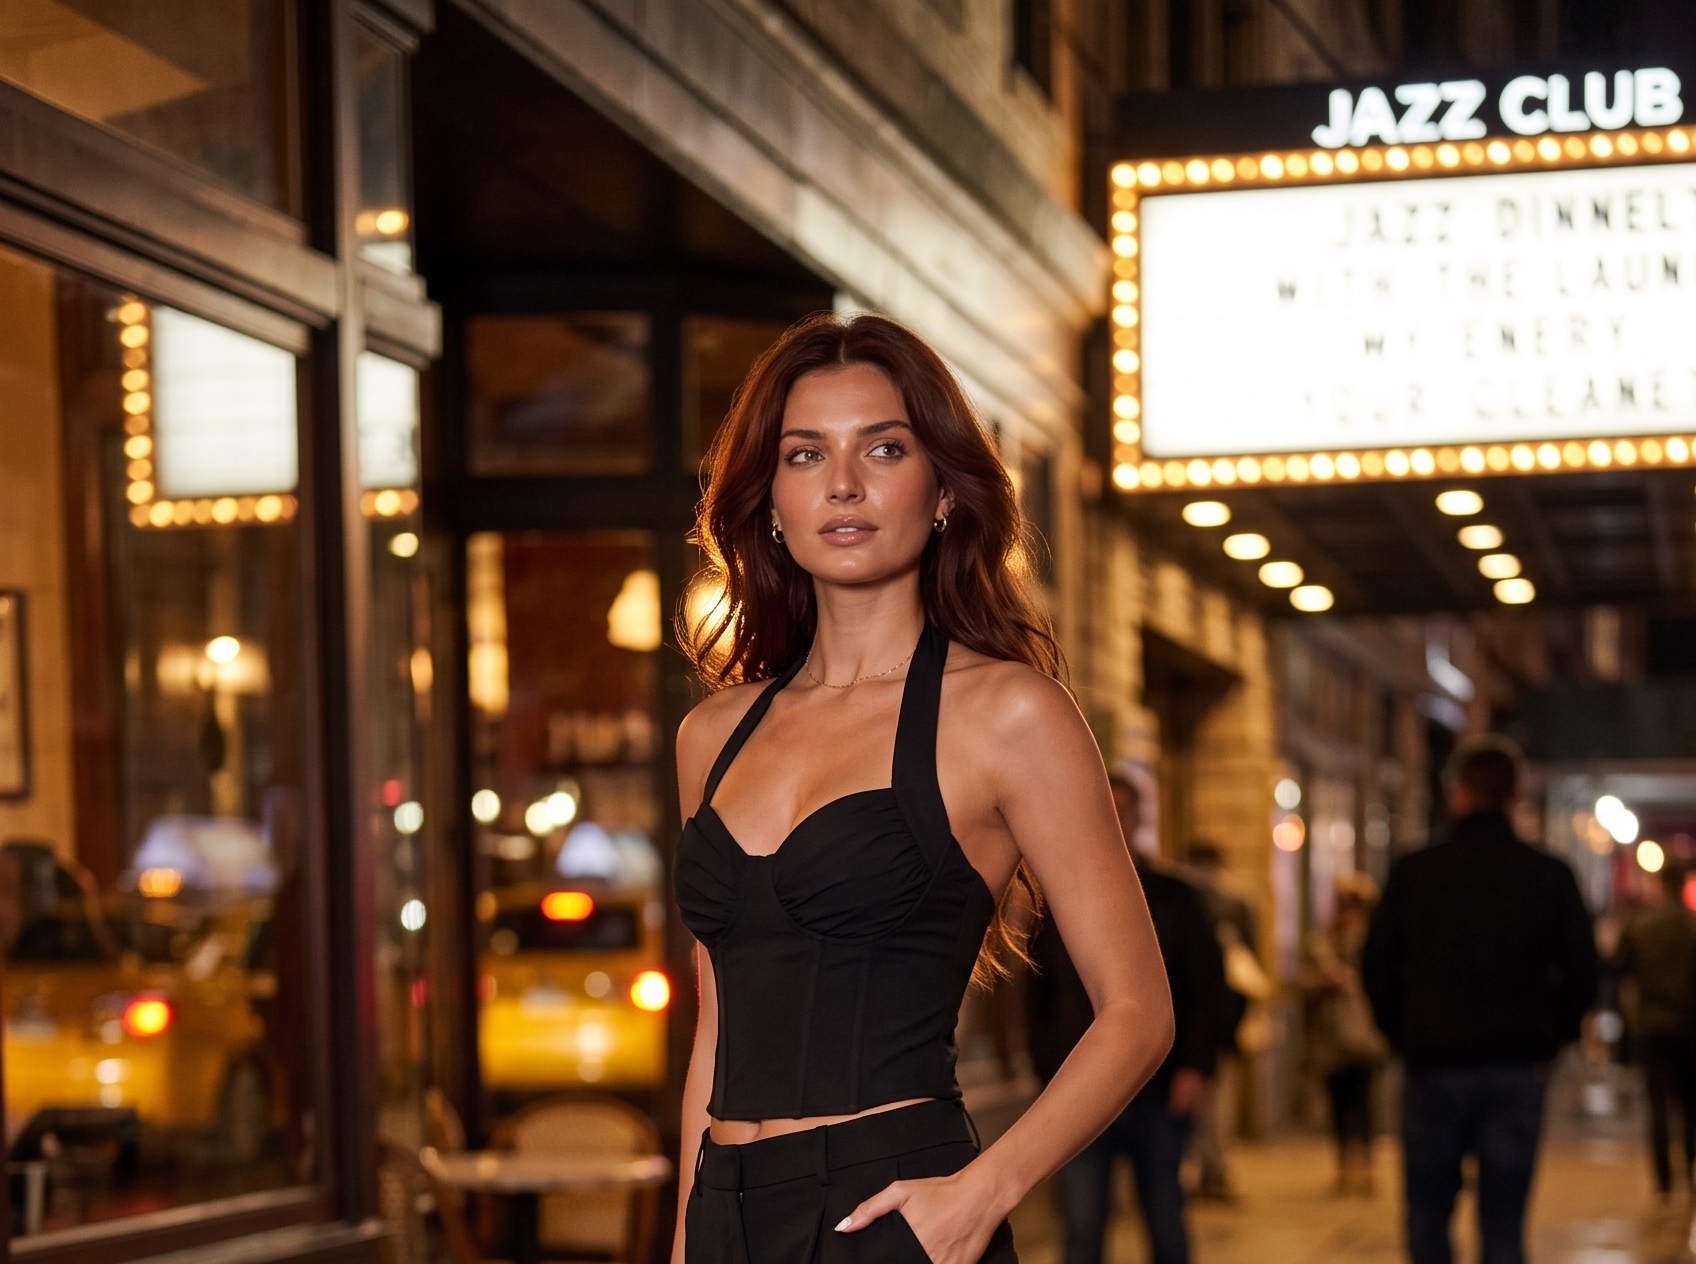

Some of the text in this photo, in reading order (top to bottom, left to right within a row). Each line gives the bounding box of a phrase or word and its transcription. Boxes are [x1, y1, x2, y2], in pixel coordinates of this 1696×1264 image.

[1311, 67, 1684, 149] JAZZ CLUB
[1332, 186, 1696, 249] JAZZ DINNEL
[1473, 367, 1696, 422] CLEANE
